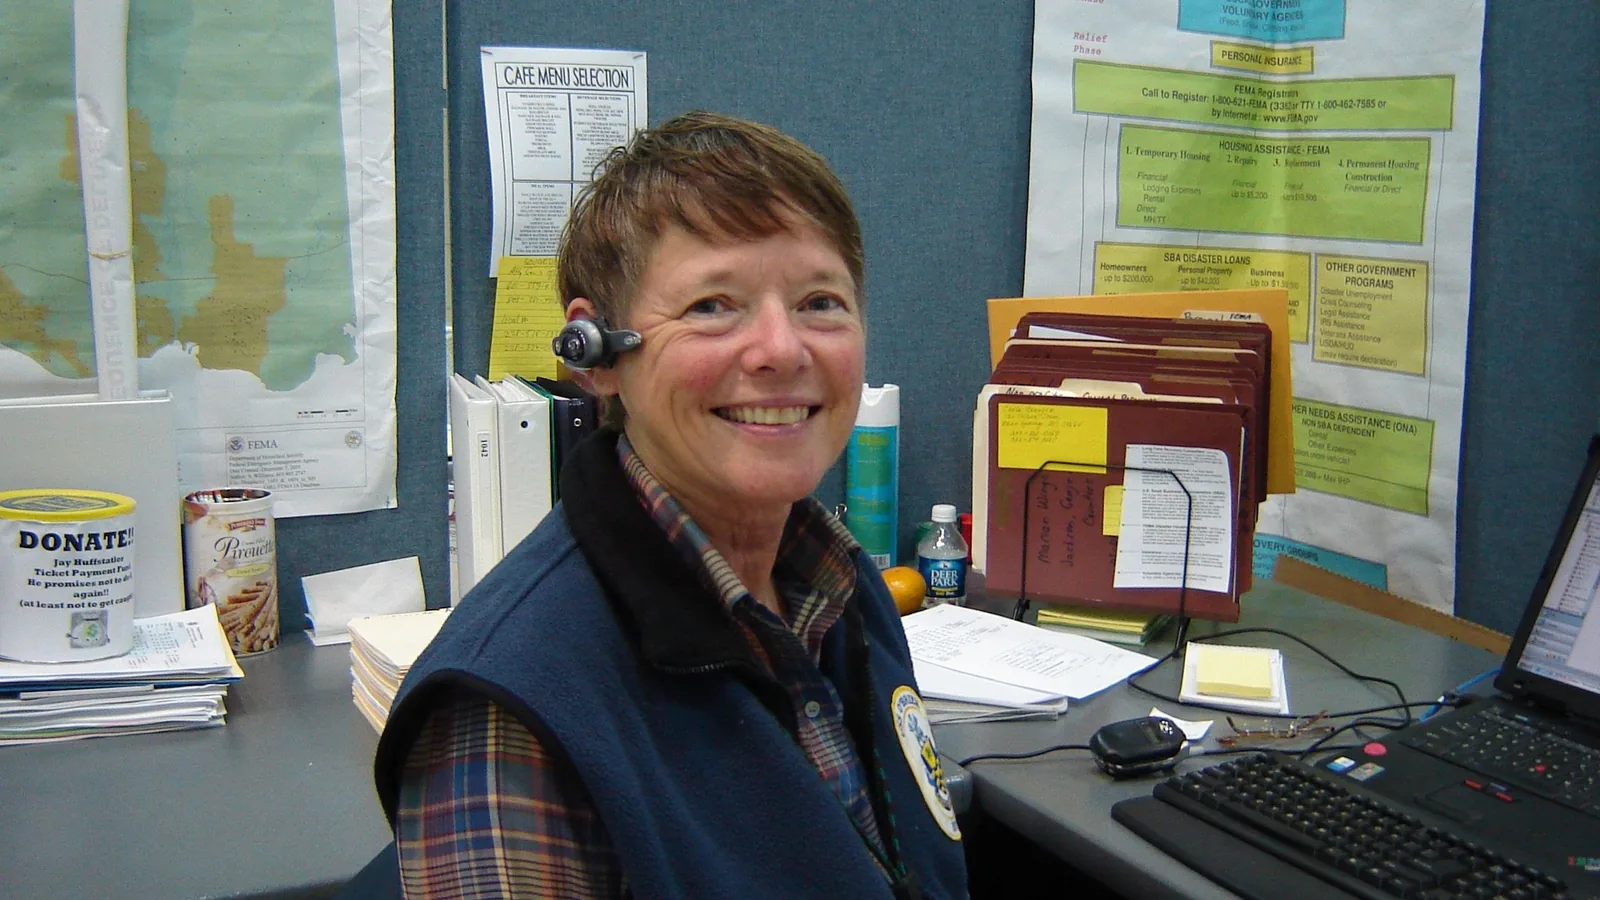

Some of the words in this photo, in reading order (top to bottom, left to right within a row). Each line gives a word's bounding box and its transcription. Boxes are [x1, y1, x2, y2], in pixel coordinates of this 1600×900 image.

[1073, 32, 1108, 43] Relief
[504, 66, 536, 85] CAFE
[538, 68, 570, 86] MENU
[573, 68, 629, 88] SELECTION
[1234, 85, 1256, 94] FEMA
[1142, 87, 1159, 98] Call
[1161, 89, 1170, 98] to
[1172, 90, 1210, 103] Register:
[1378, 100, 1386, 108] or
[1212, 108, 1222, 118] by
[1219, 141, 1252, 152] HOUSING
[1307, 146, 1330, 154] FEMA
[1135, 146, 1178, 159] Temporary
[1180, 150, 1210, 162] Housing
[1346, 160, 1386, 169] Permanent
[1388, 160, 1420, 170] Housing
[1345, 172, 1393, 182] Construction
[1163, 252, 1182, 262] SBA
[1183, 254, 1223, 264] DISASTER
[1224, 255, 1251, 266] LOANS
[1100, 262, 1148, 272] Homeowners
[1178, 266, 1206, 274] Personal
[1326, 262, 1354, 272] OTHER
[1356, 264, 1416, 278] GOVERNMENT
[1250, 268, 1284, 278] Business
[1345, 276, 1394, 290] PROGRAMS
[1308, 407, 1336, 421] NEEDS
[1337, 412, 1391, 430] ASSISTANCE
[1393, 420, 1418, 436] (ONA)
[1302, 418, 1316, 427] NON
[1333, 424, 1376, 438] DEPENDENT
[248, 440, 278, 450] FEMA
[19, 527, 134, 552] DONATE!!
[1254, 539, 1285, 552] OVERY
[54, 558, 71, 568] Jay
[34, 568, 69, 577] Ticket
[72, 567, 116, 578] Payment
[931, 570, 958, 580] DEER
[28, 578, 42, 587] He
[44, 579, 97, 590] promises
[931, 578, 958, 587] PARK
[73, 589, 109, 598] again!!
[20, 600, 34, 608] (at
[36, 600, 64, 609] least
[100, 599, 114, 608] get
